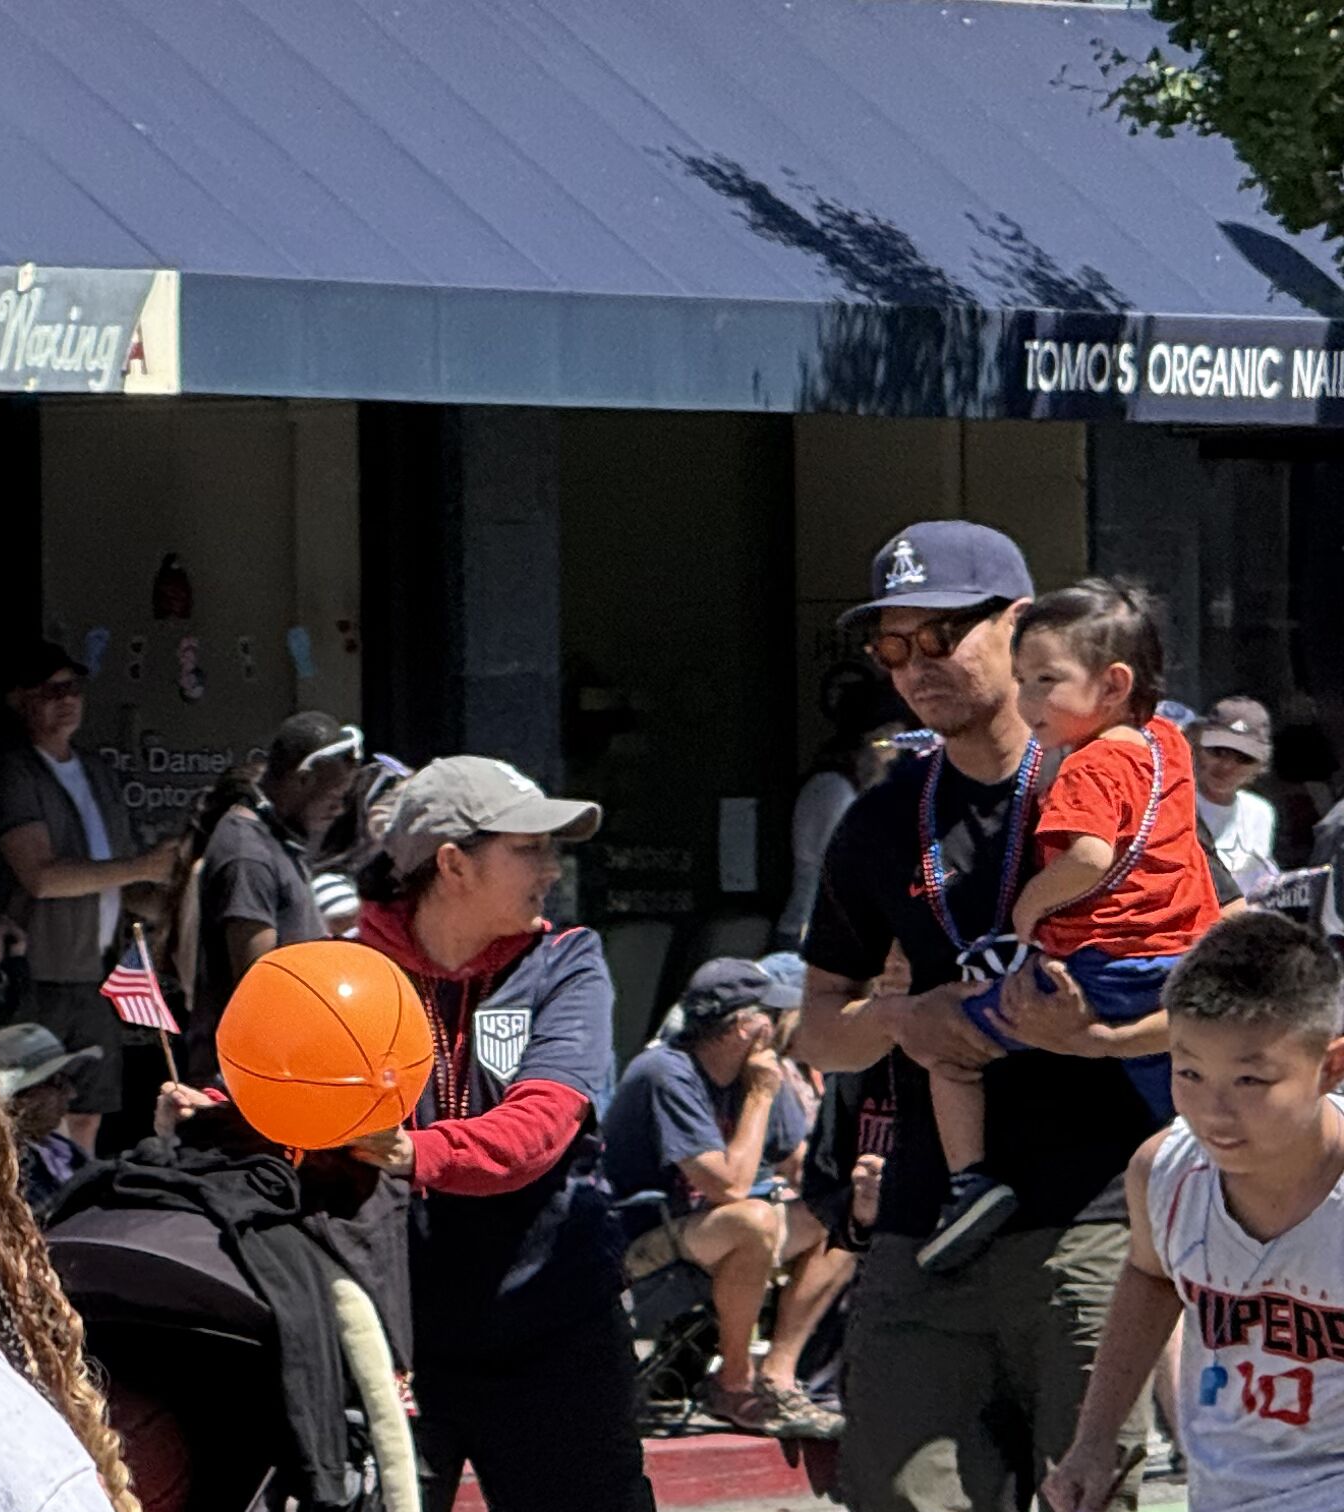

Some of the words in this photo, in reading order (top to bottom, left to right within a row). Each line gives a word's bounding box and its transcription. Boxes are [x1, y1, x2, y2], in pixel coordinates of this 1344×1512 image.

[1024, 341, 1137, 395] TOMO'S
[1147, 343, 1284, 399] ORGANIC
[482, 1015, 524, 1039] USA
[1236, 1360, 1315, 1427] 10
